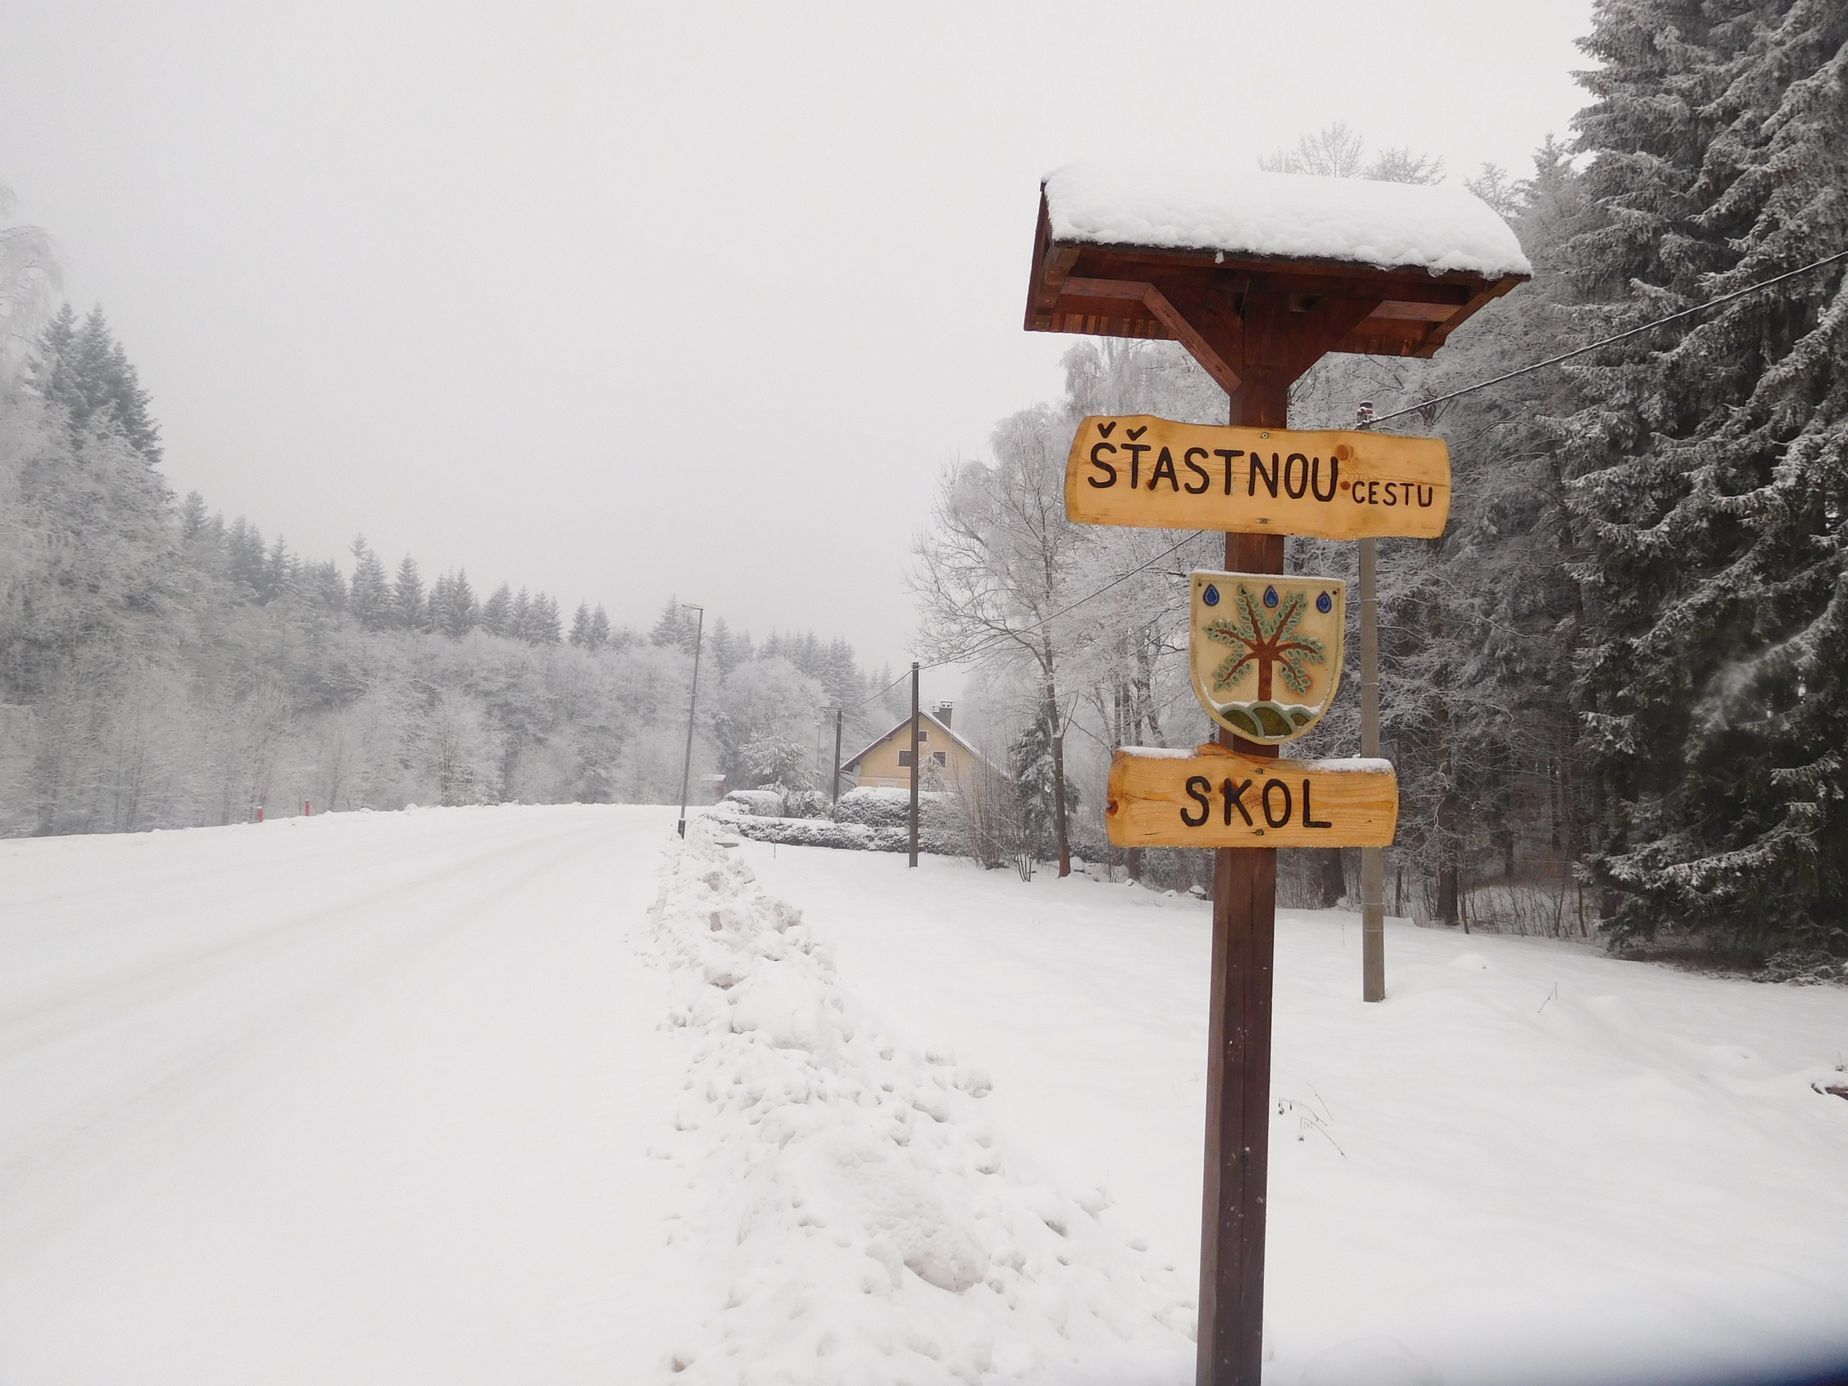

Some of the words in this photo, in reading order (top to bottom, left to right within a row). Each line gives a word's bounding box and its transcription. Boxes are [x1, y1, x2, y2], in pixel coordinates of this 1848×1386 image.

[1087, 421, 1339, 502] ŠŤASTNOU
[1351, 480, 1433, 508] CESTU
[1180, 775, 1332, 829] SKOL
